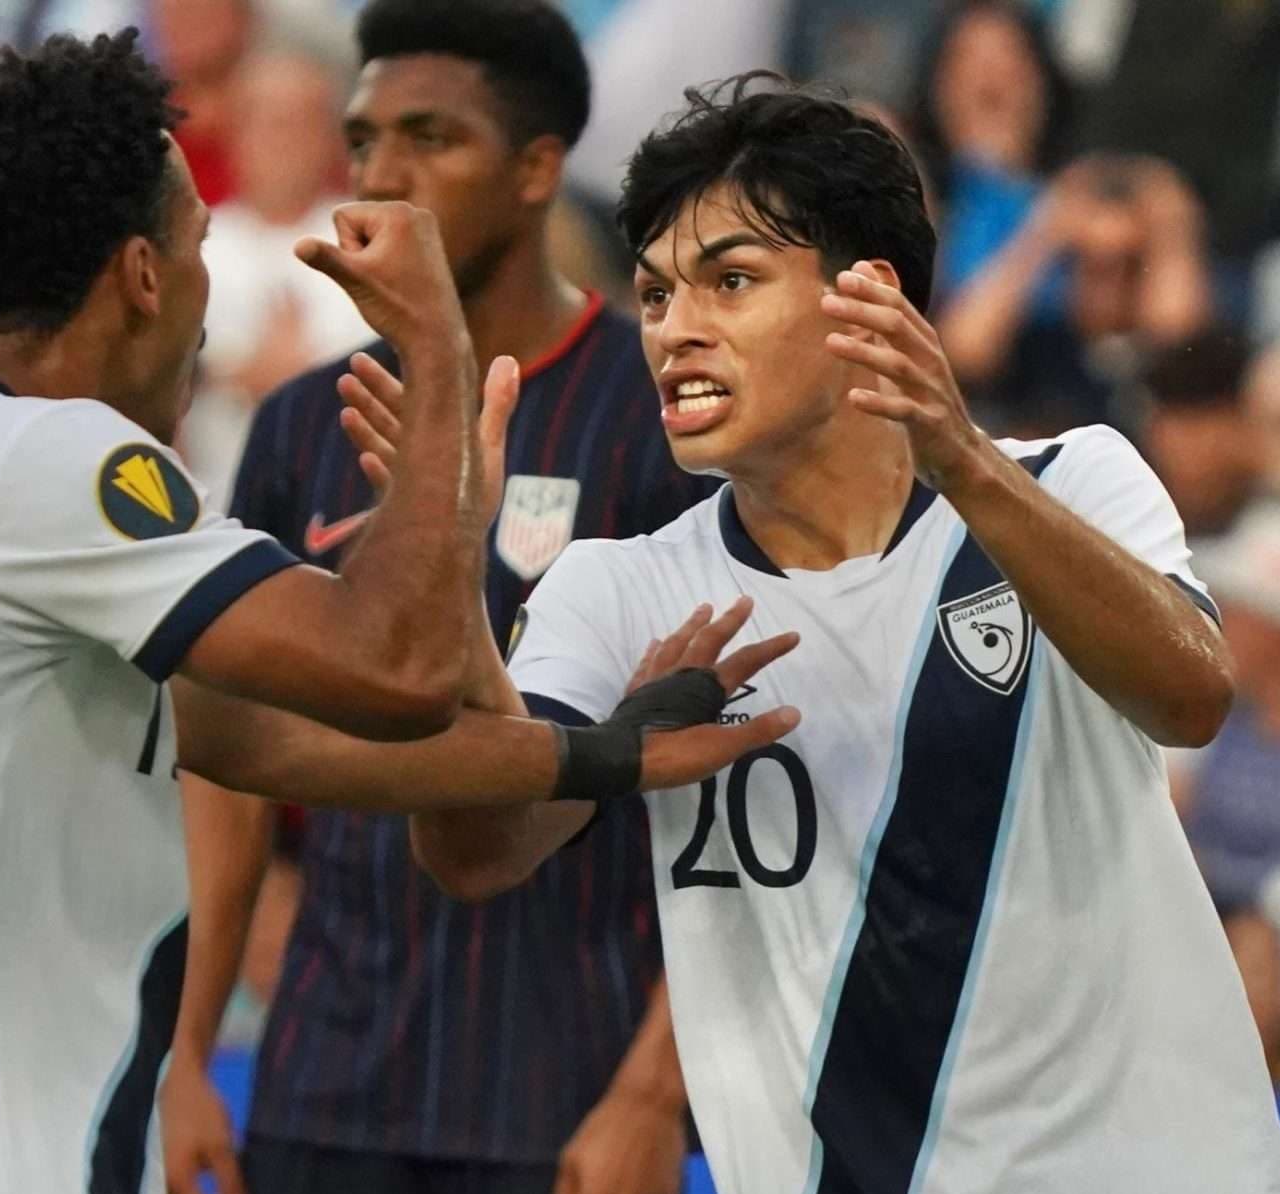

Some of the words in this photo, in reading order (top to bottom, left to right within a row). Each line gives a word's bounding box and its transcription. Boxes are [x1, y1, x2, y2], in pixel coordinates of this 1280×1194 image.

[951, 594, 1015, 623] GUATEMALA
[719, 706, 751, 725] bro
[671, 742, 818, 890] 20
